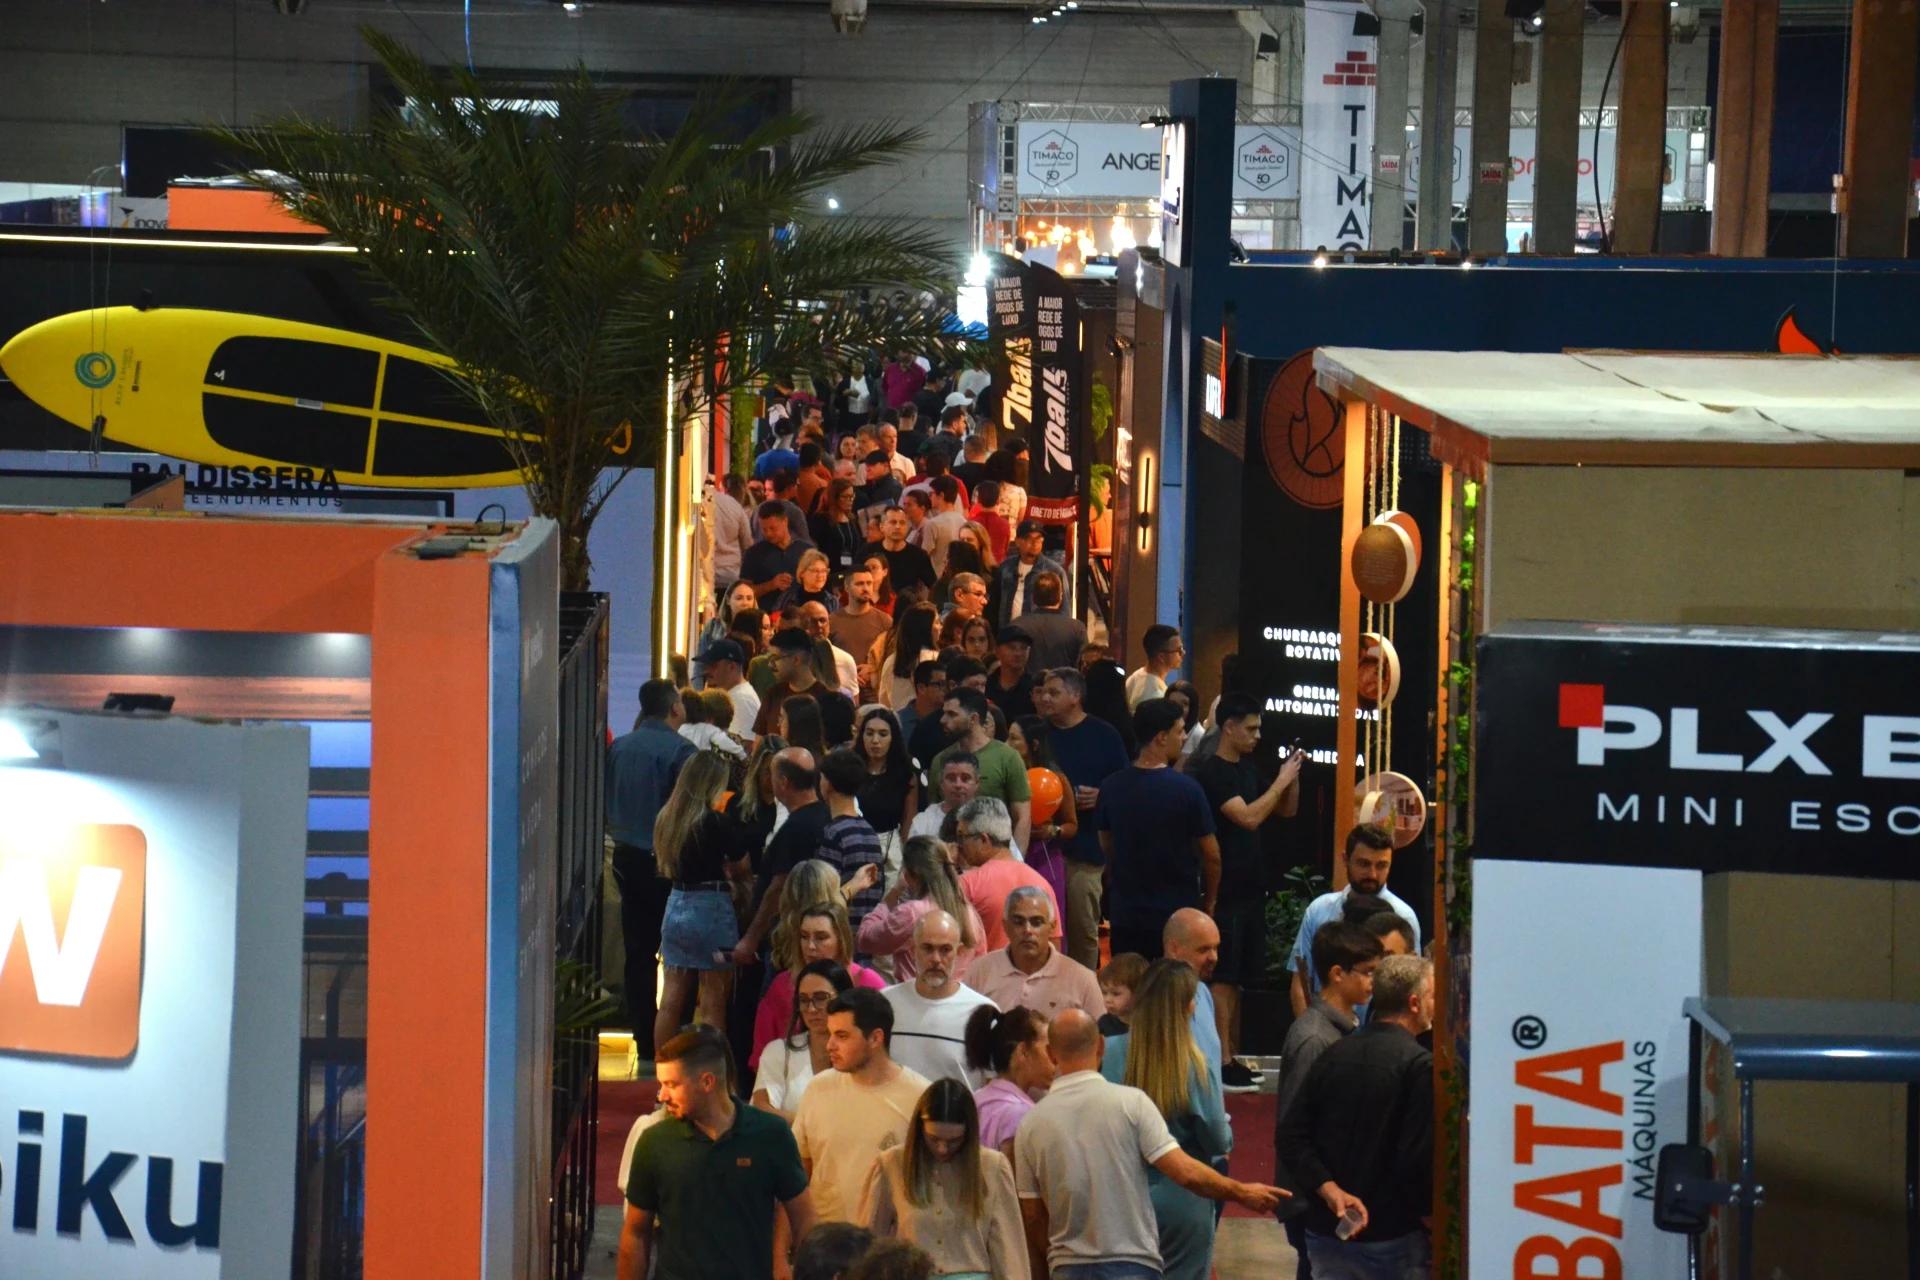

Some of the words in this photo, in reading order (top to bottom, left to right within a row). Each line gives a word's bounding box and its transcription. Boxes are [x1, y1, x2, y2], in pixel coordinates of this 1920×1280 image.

[1032, 151, 1074, 161] TIMACO
[1102, 152, 1160, 171] ANGE
[1243, 154, 1285, 164] TIMACO
[1046, 170, 1060, 180] 50
[1257, 173, 1270, 184] 50
[1000, 276, 1021, 288] MAIOR
[995, 289, 1012, 301] REDE
[1013, 289, 1022, 300] DE
[996, 301, 1014, 313] JOGOS
[1015, 301, 1024, 312] DE
[1038, 296, 1043, 308] A
[1044, 296, 1063, 310] MAIOR
[1002, 313, 1019, 326] LUXO
[1038, 311, 1053, 323] REDE
[1054, 311, 1062, 324] DE
[1055, 326, 1063, 338] DE
[1041, 340, 1057, 352] LUXO
[1577, 704, 1834, 776] PLX
[1598, 792, 1743, 827] MINI
[1627, 1040, 1657, 1201] MÁQUINAS
[0, 1109, 224, 1250] iku
